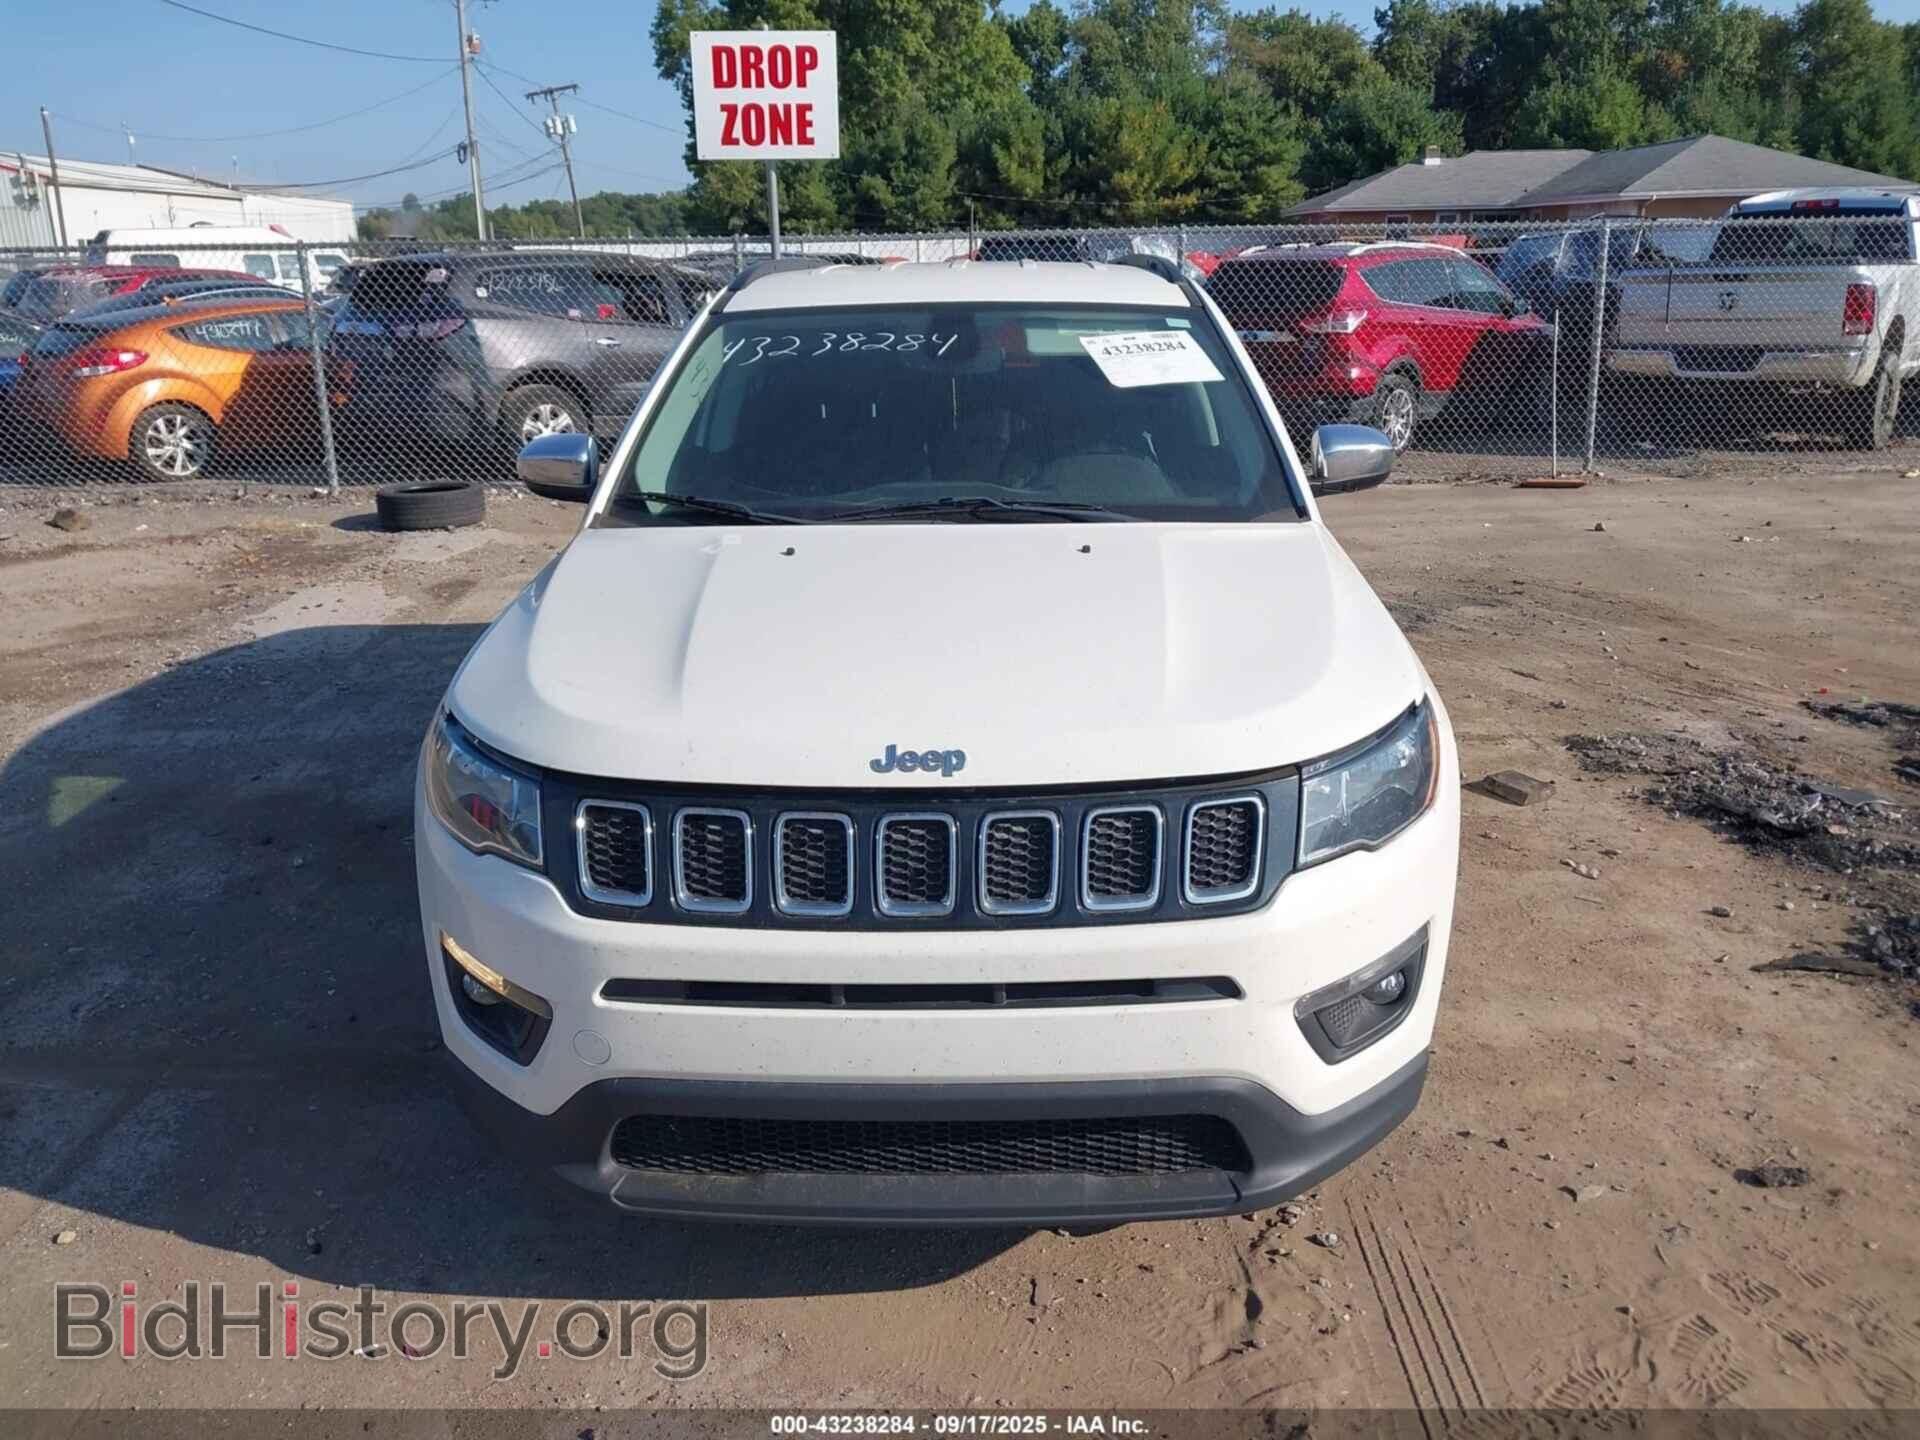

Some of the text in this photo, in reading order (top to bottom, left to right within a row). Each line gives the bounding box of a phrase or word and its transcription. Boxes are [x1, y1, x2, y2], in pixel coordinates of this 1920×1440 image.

[711, 44, 819, 89] DROP
[720, 103, 815, 146] ZONE
[1102, 341, 1187, 356] 43238284
[869, 744, 966, 777] Jeep
